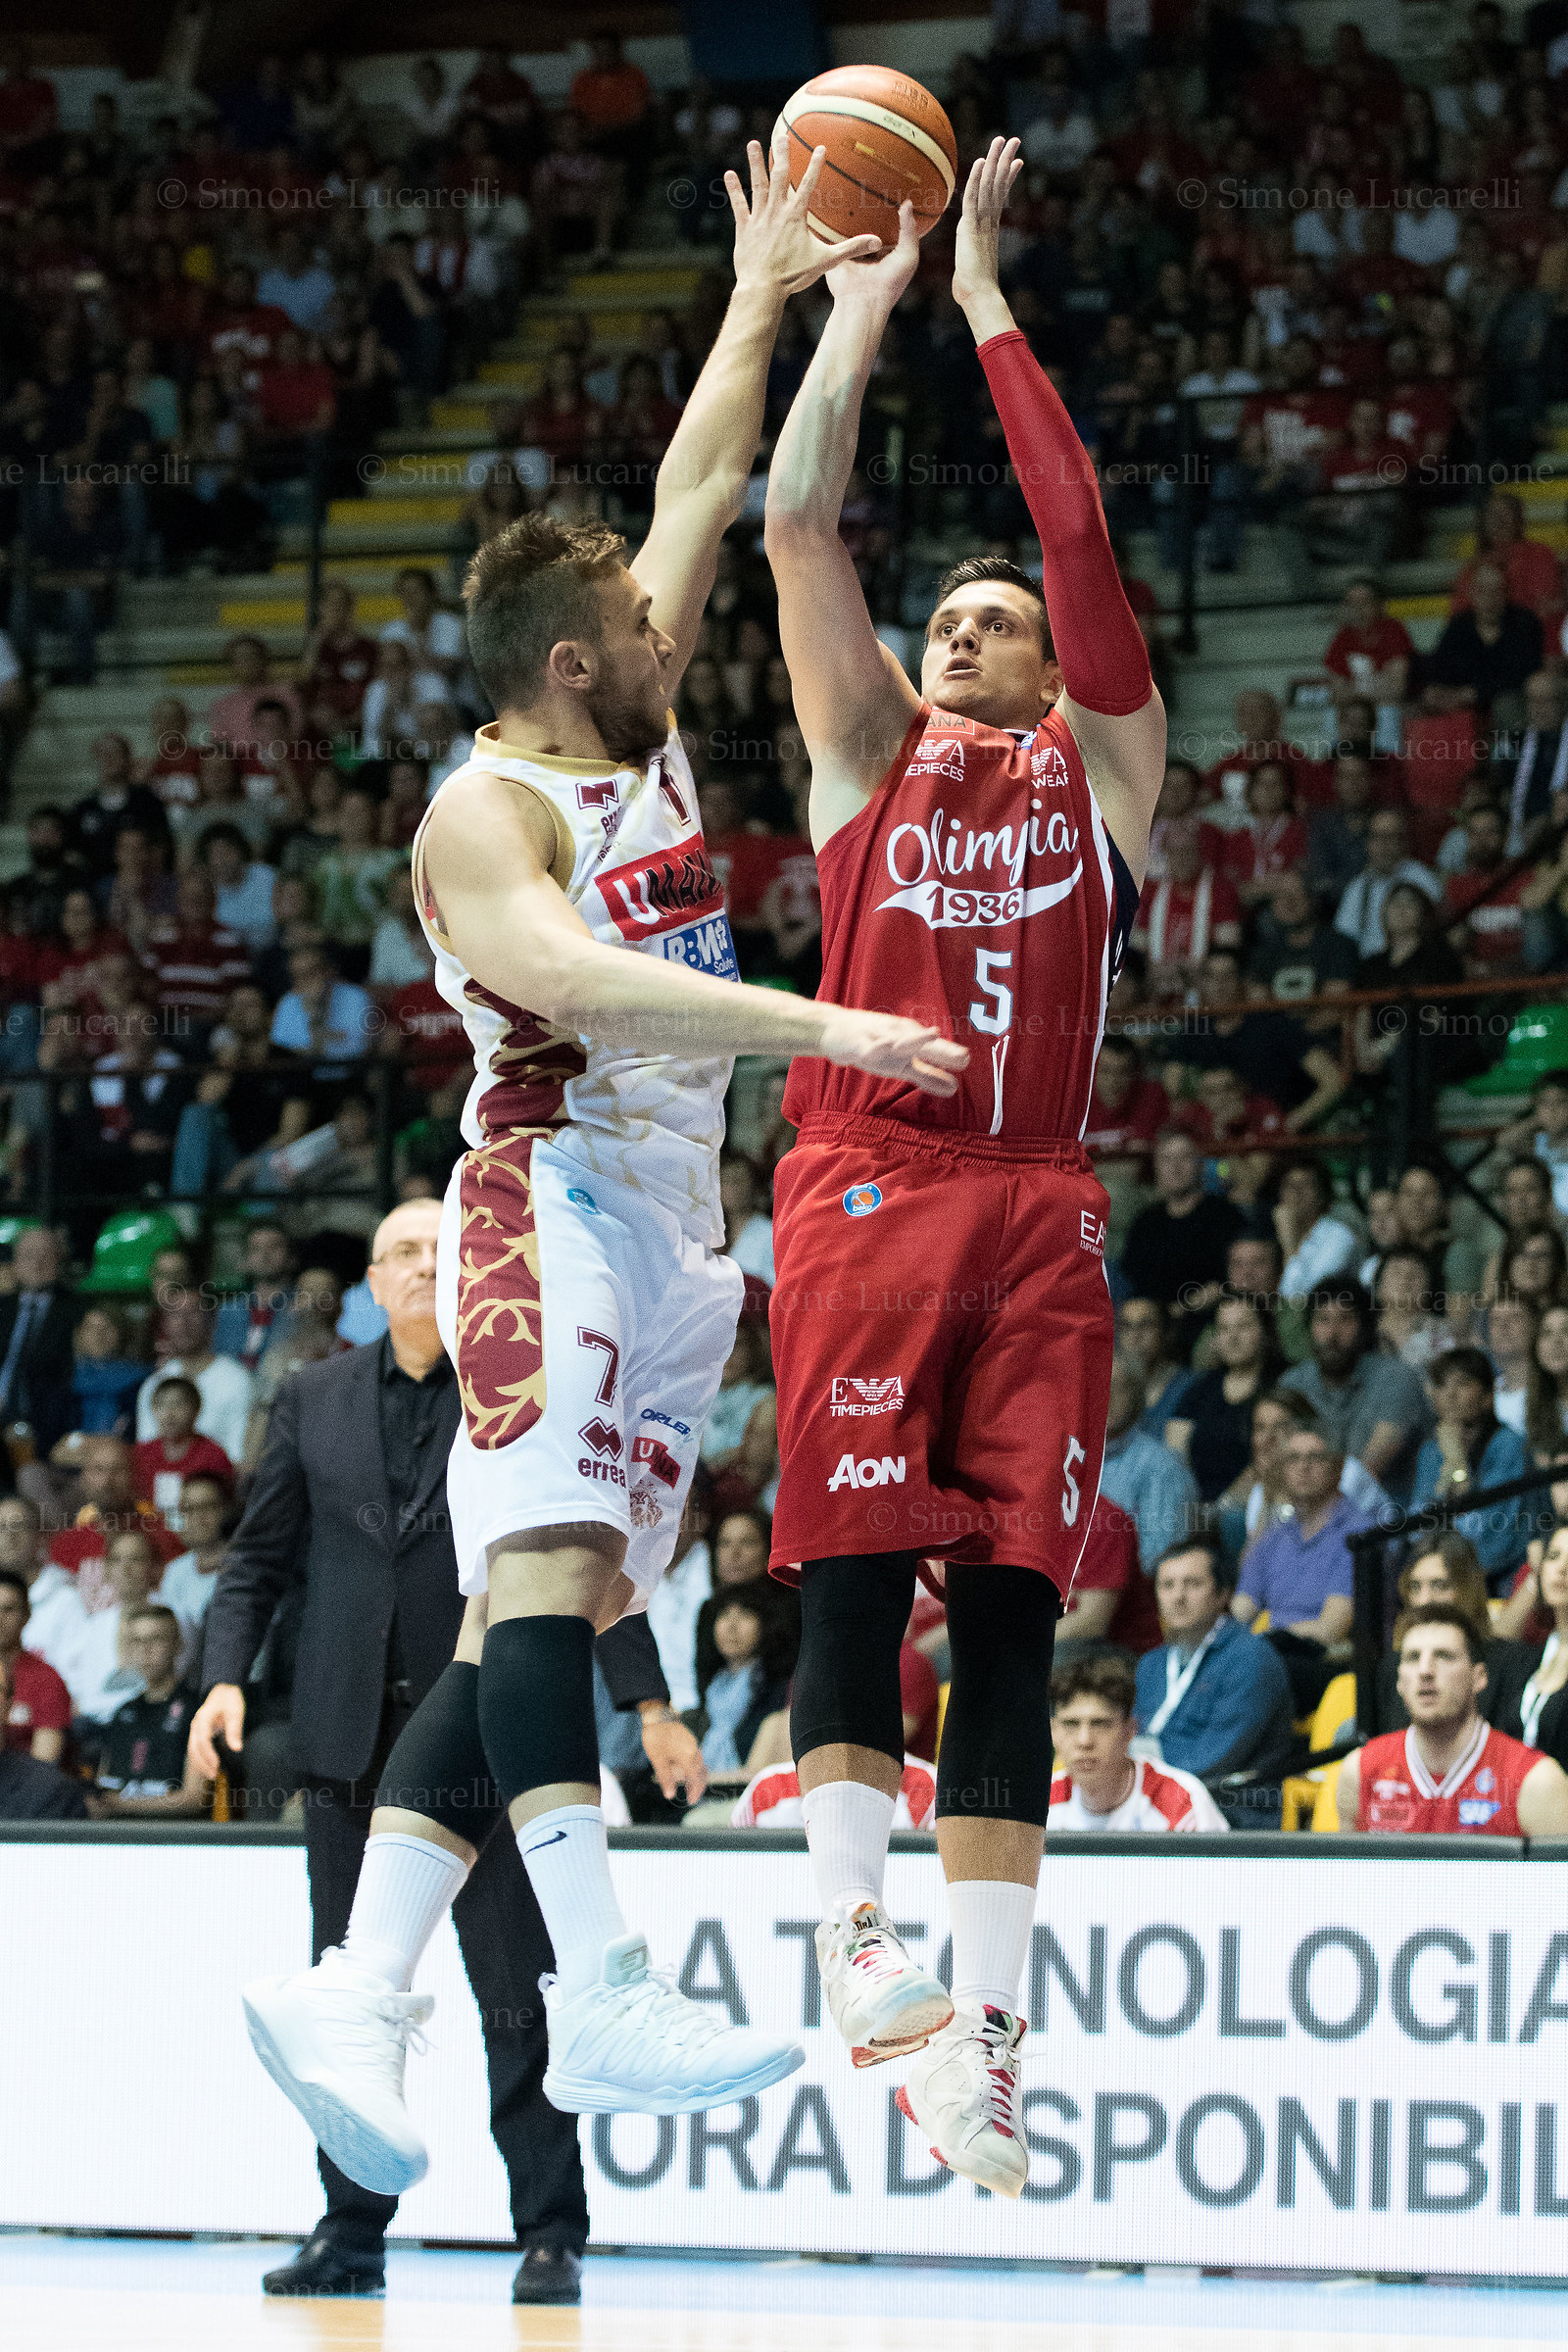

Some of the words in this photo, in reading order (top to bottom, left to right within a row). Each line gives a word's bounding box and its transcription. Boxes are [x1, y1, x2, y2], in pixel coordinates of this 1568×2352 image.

[886, 799, 1079, 887] Olimpia
[926, 886, 1021, 925] 1936
[968, 947, 1013, 1037] 5
[576, 1326, 619, 1407] 7
[829, 1397, 905, 1417] TIMEPIECES
[1061, 1435, 1087, 1527] 5
